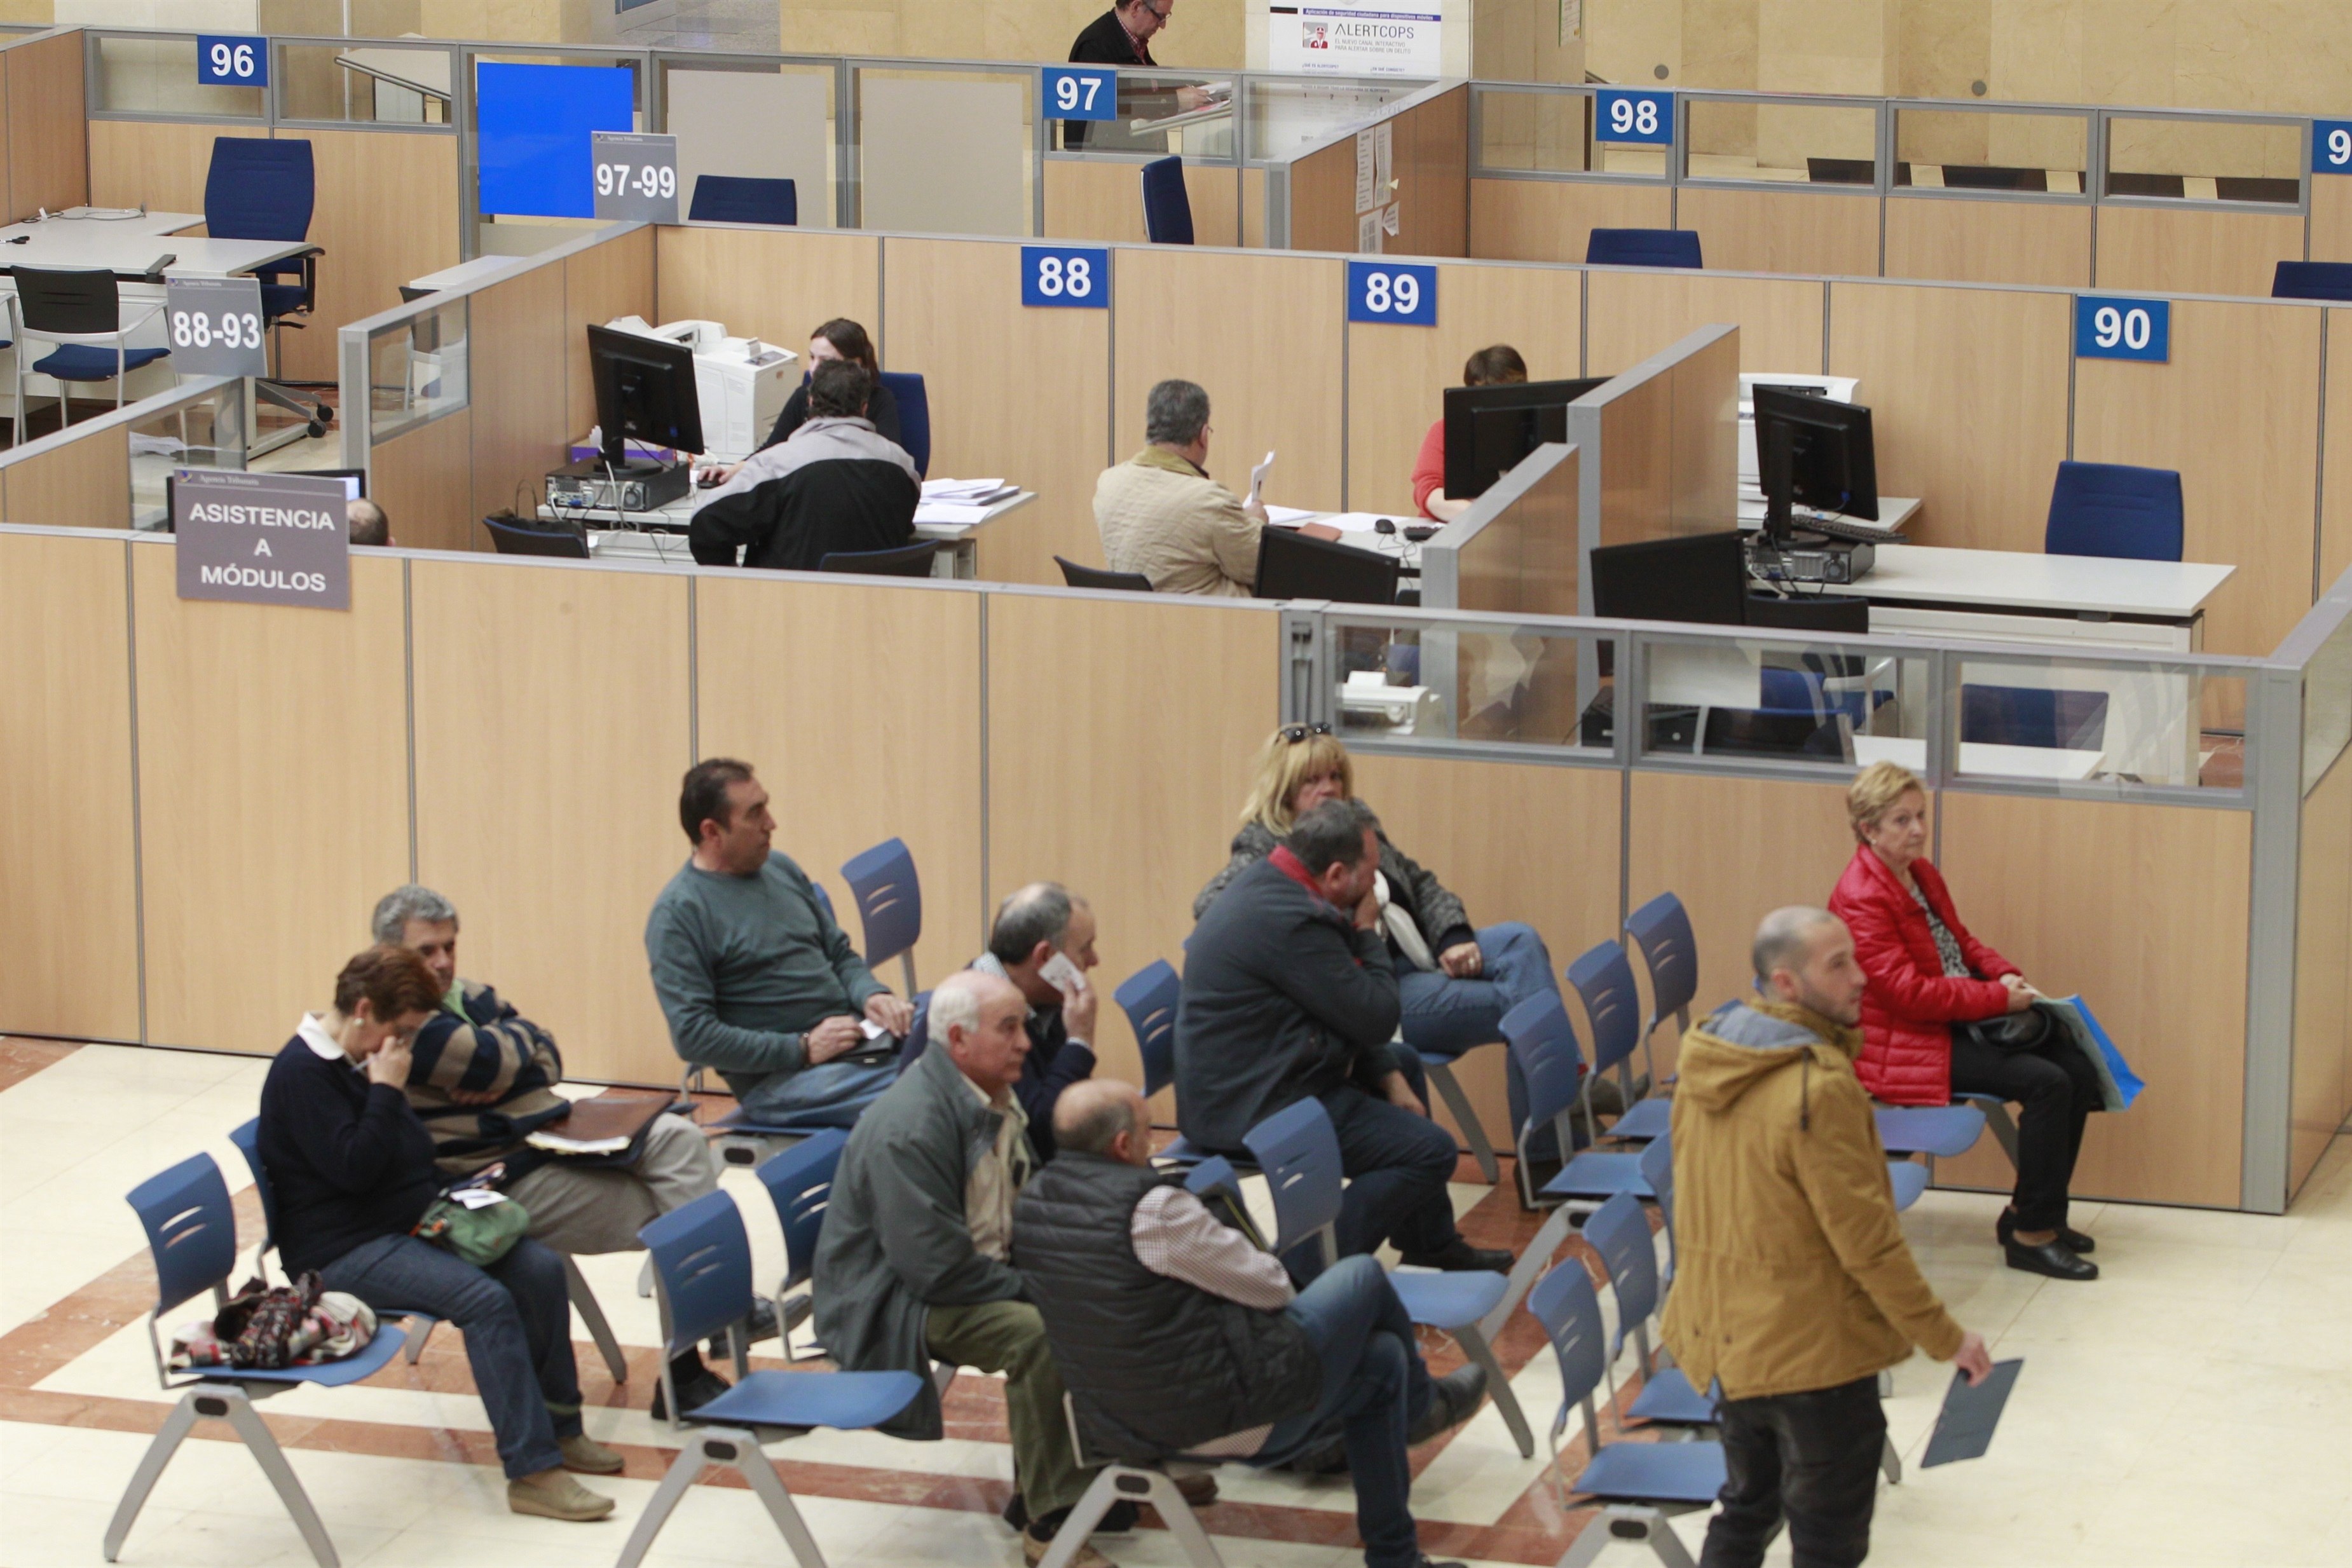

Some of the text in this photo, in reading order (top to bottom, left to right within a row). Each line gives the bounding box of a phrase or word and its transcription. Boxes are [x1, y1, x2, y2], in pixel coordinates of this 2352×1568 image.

[1335, 23, 1414, 39] ALERTCOPS
[210, 43, 254, 78] 96
[1056, 76, 1102, 111] 97
[1611, 99, 1658, 135] 98
[596, 163, 676, 198] 97-99
[1039, 256, 1091, 297] 88
[1365, 272, 1419, 314] 89
[173, 311, 261, 349] 88-93
[2095, 306, 2150, 350] 90
[189, 503, 336, 531] ASISTENCIA
[254, 538, 273, 557] A
[201, 562, 326, 592] MÓDULOS
